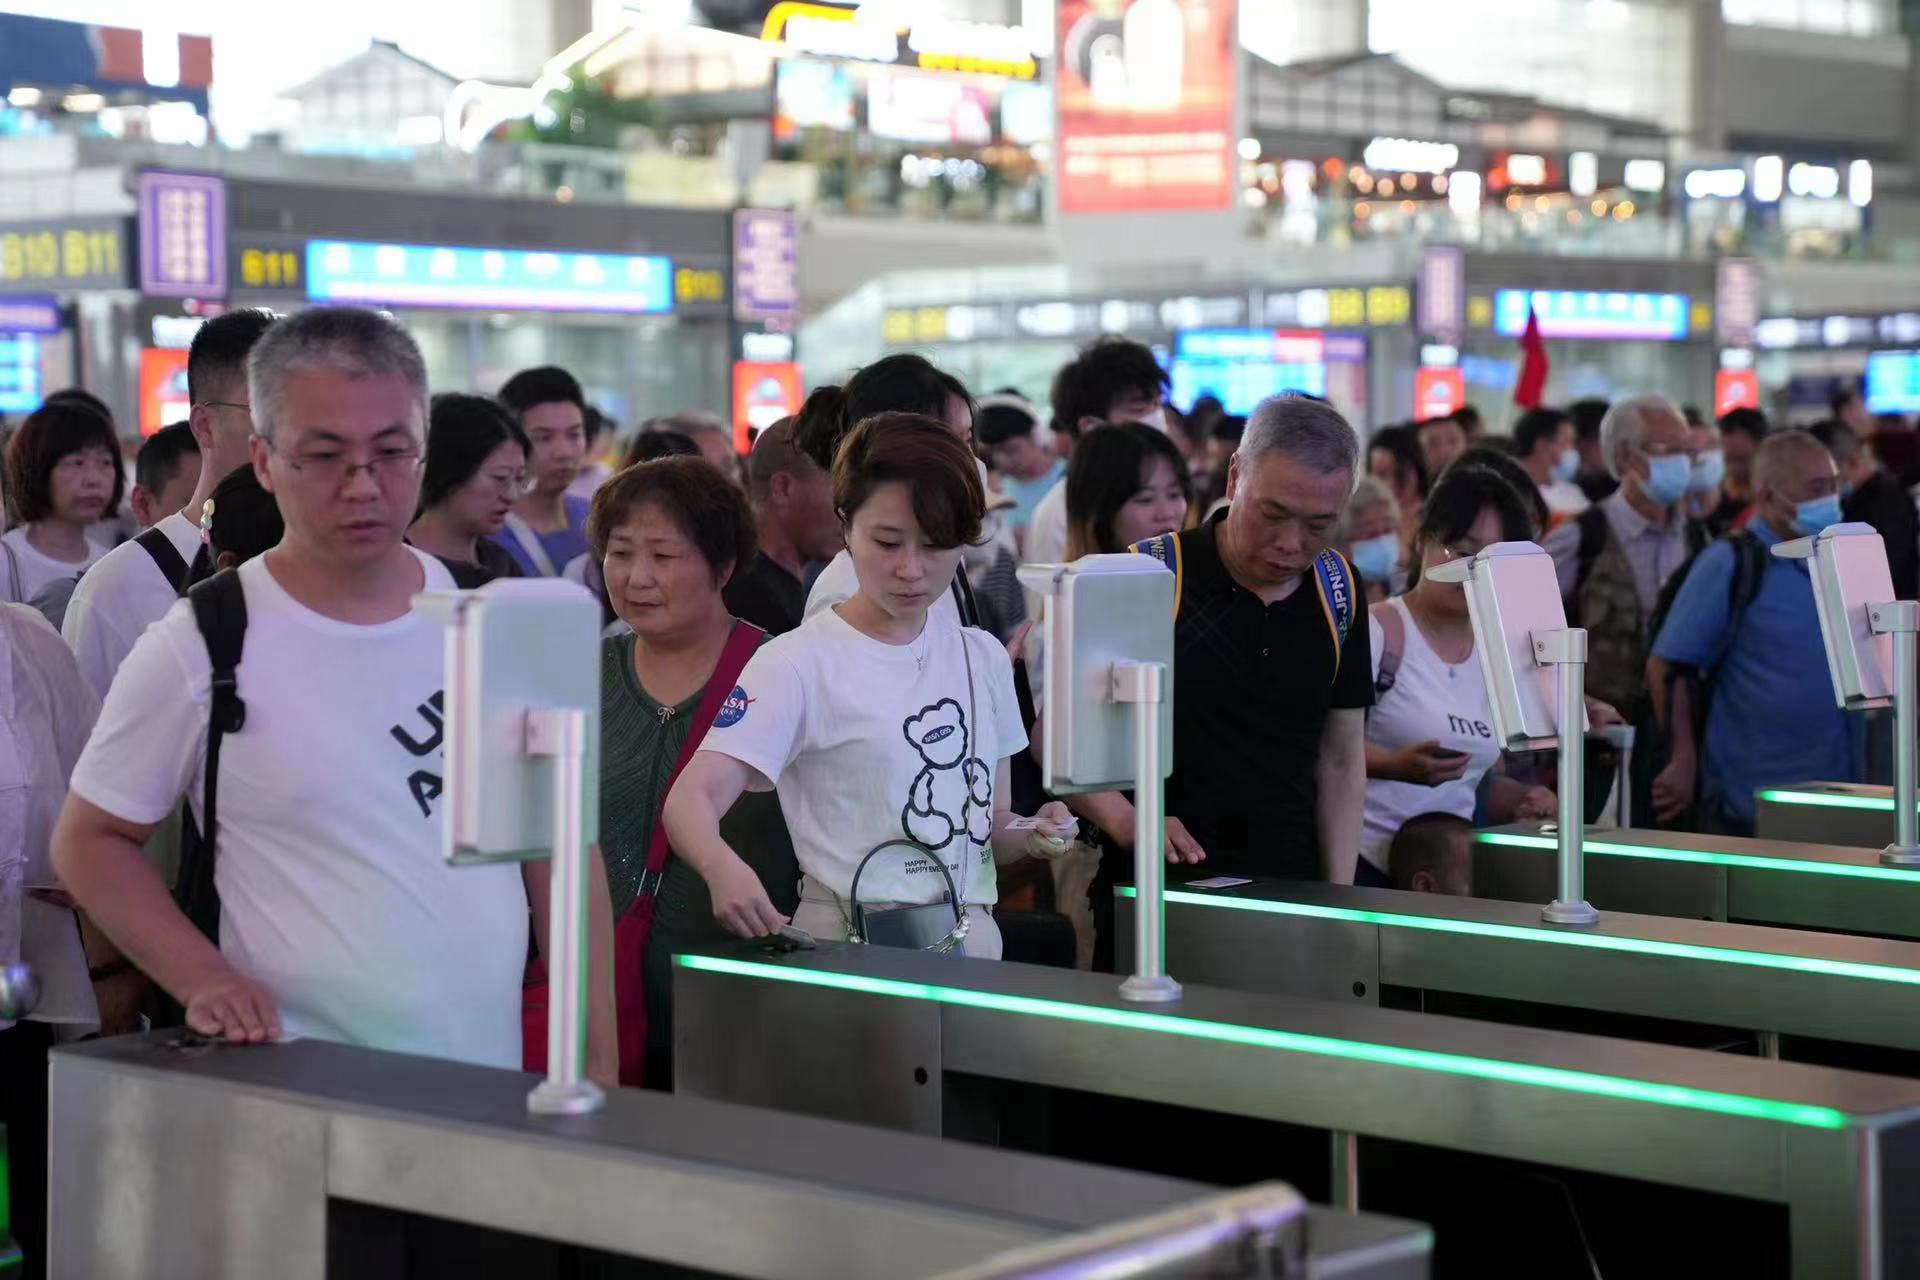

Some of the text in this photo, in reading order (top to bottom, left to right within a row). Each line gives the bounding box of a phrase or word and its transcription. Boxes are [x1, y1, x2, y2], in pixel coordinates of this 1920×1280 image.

[1330, 574, 1348, 616] JPN
[1447, 713, 1491, 739] me
[906, 866, 928, 874] HAPPY
